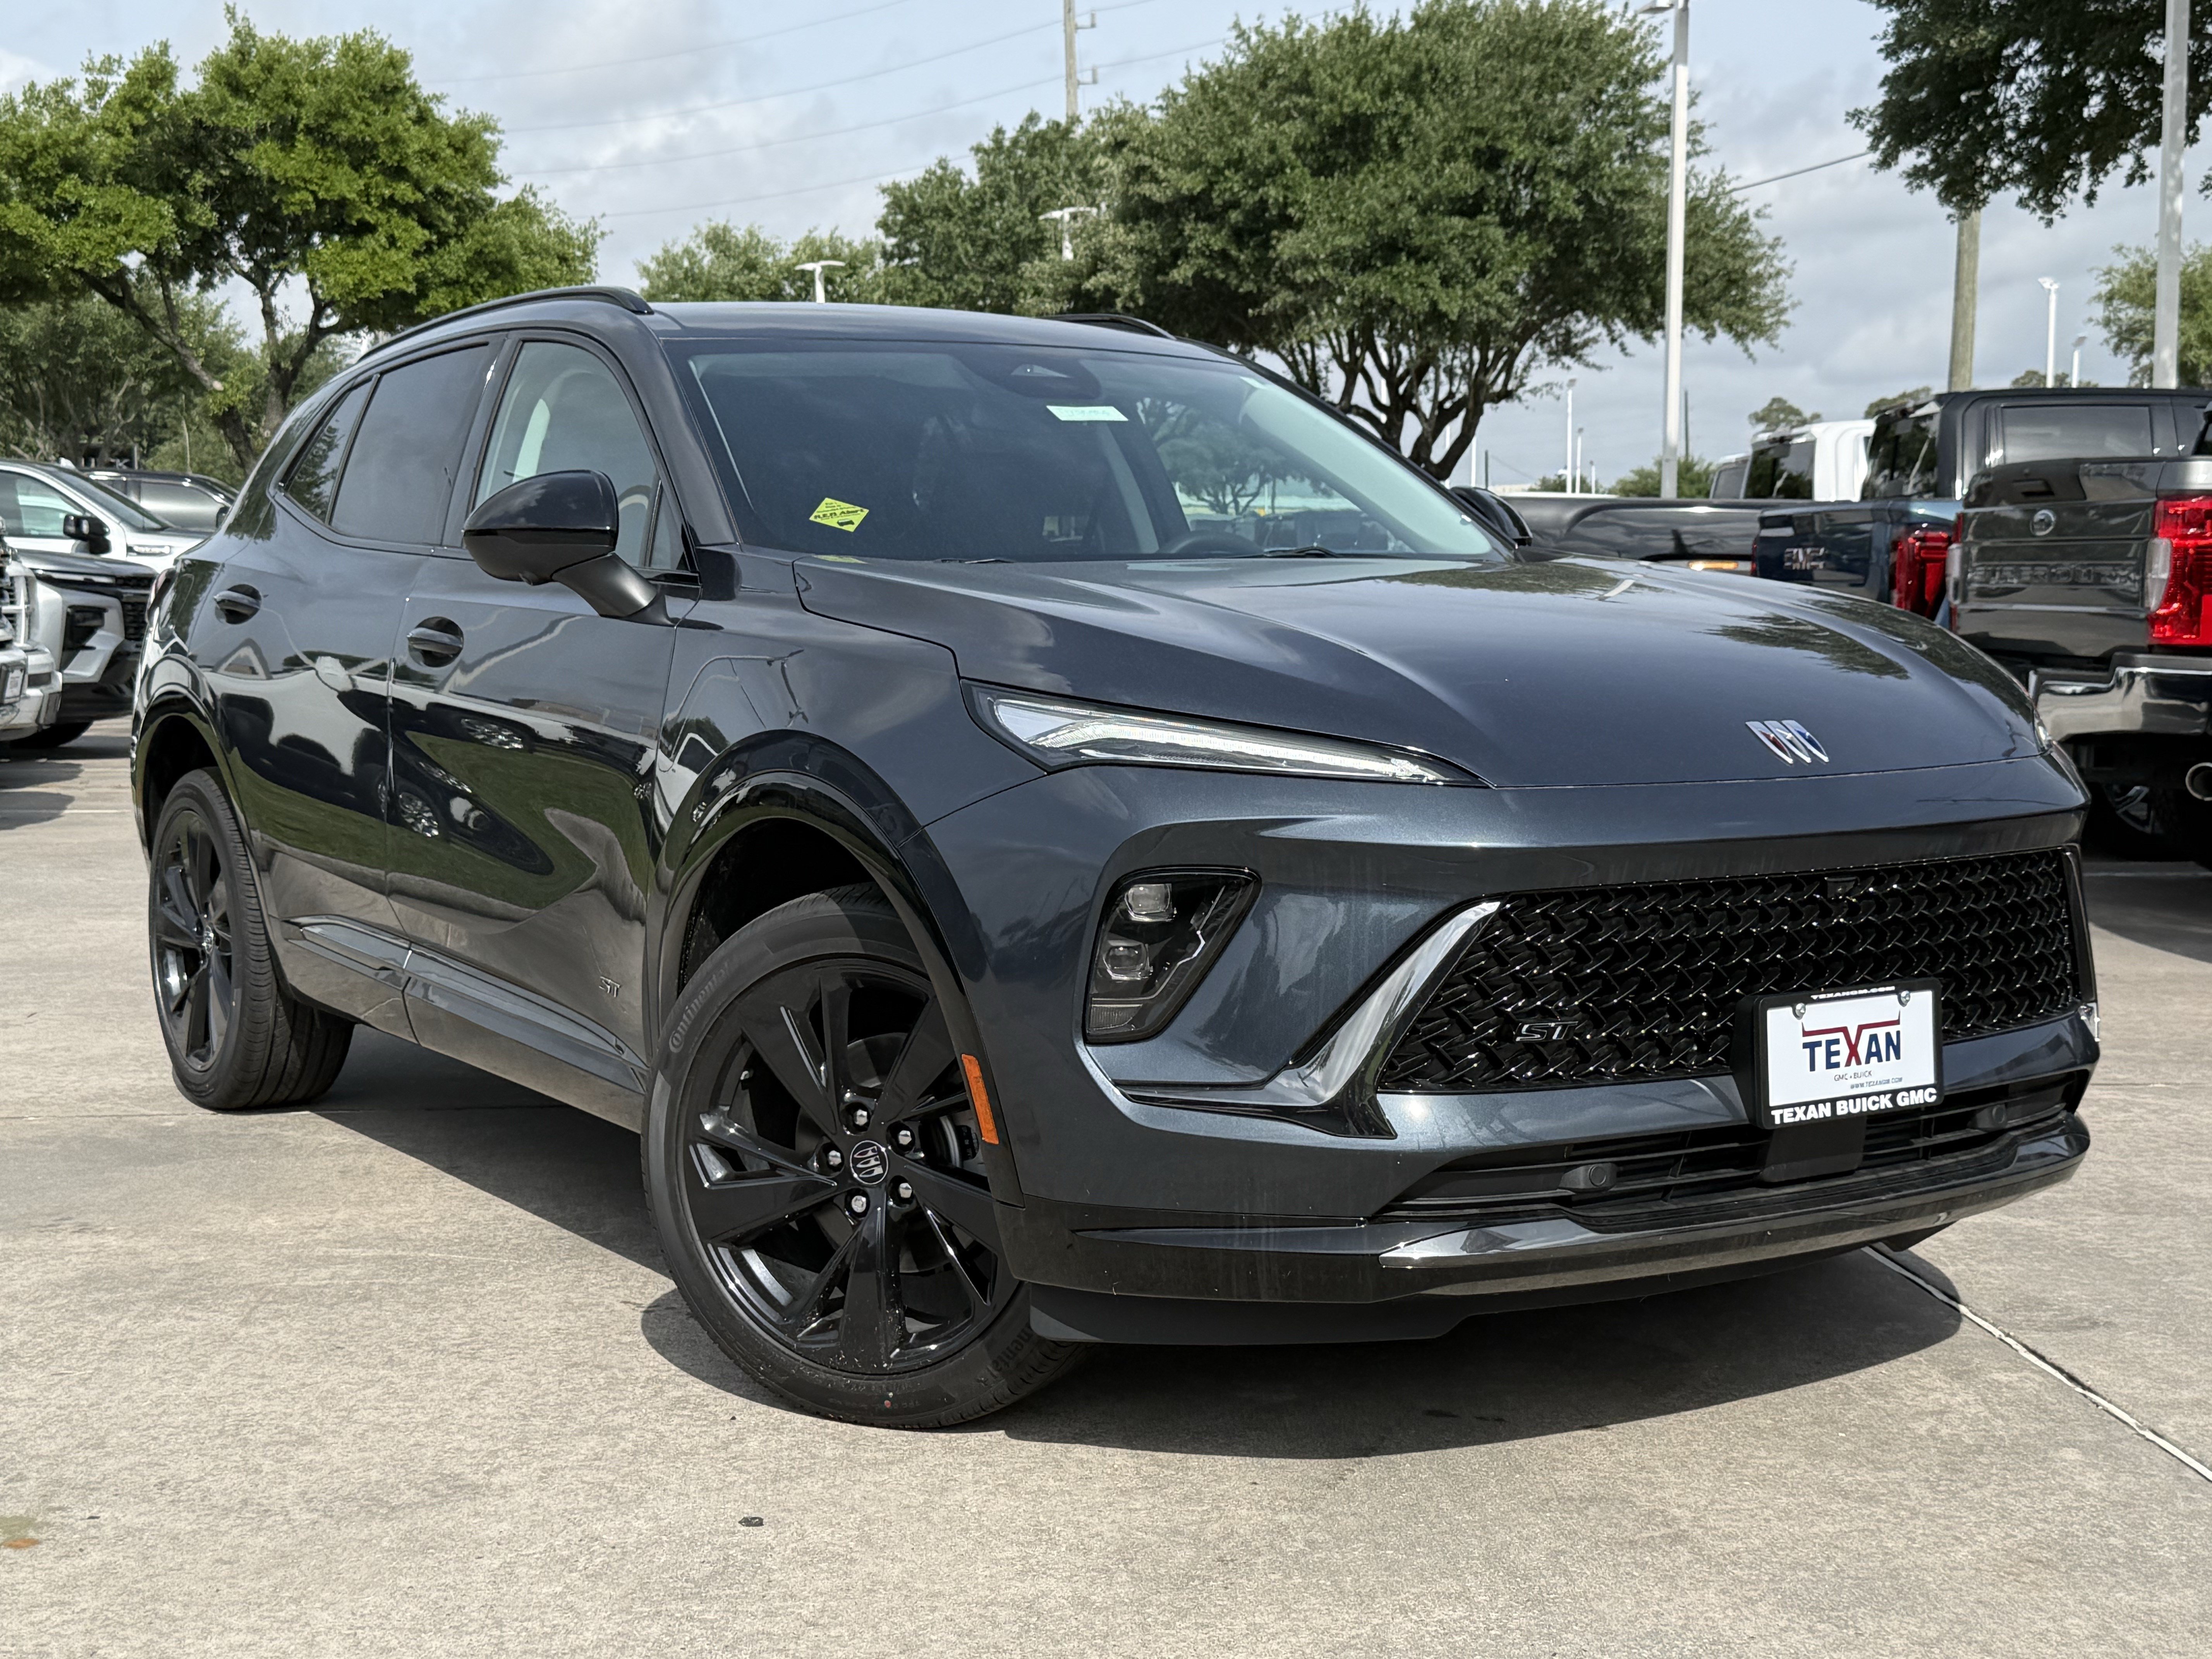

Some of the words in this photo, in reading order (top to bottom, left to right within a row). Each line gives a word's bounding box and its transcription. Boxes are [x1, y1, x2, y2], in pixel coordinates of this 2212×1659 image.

[599, 976, 620, 998] ST
[1515, 1020, 1579, 1042] ST
[1802, 1022, 1901, 1072] TEXAN
[1834, 1073, 1848, 1082] GMC
[1853, 1070, 1872, 1079] BUICK
[1771, 1102, 1832, 1125] TEXAN
[1836, 1094, 1893, 1116] BUICK
[1896, 1087, 1937, 1107] GMC
